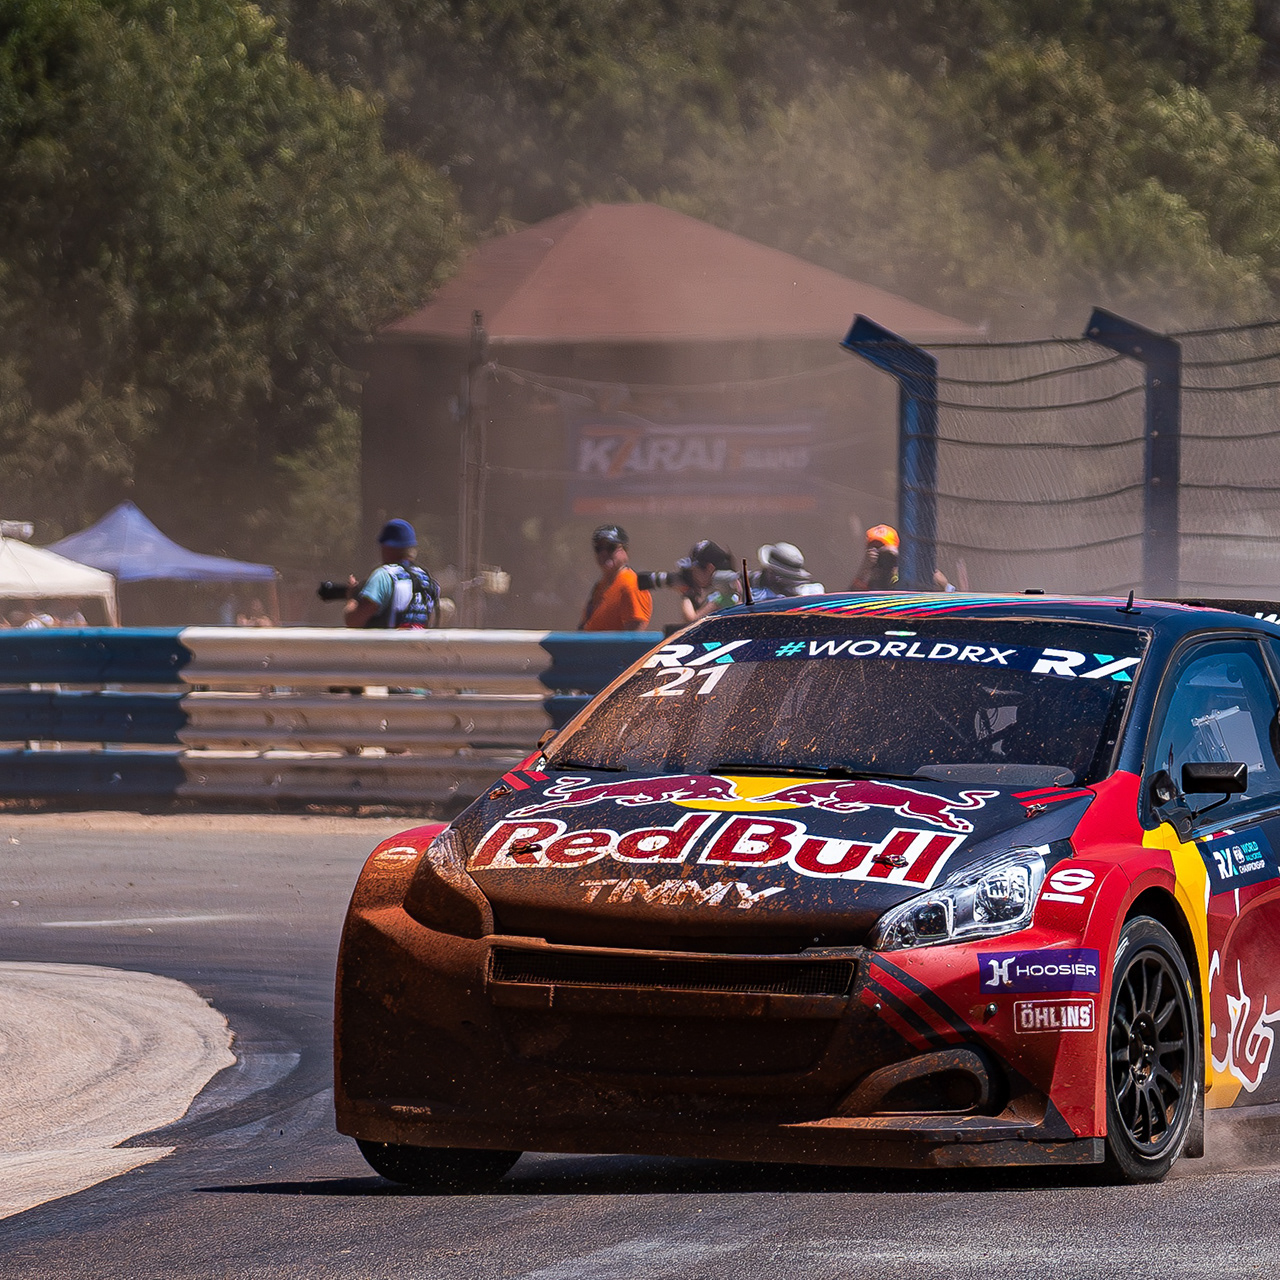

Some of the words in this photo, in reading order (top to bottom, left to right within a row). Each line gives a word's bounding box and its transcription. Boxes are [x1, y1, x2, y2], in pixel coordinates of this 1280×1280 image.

[640, 639, 752, 668] RX
[775, 638, 1017, 665] #WORLDRX
[1031, 647, 1141, 682] RX
[638, 664, 730, 698] 21
[470, 812, 714, 871] Red
[702, 816, 962, 888] Bull
[1213, 848, 1239, 879] RX
[1016, 964, 1097, 977] HOOSIER
[1020, 1002, 1091, 1029] ÖHLINS
